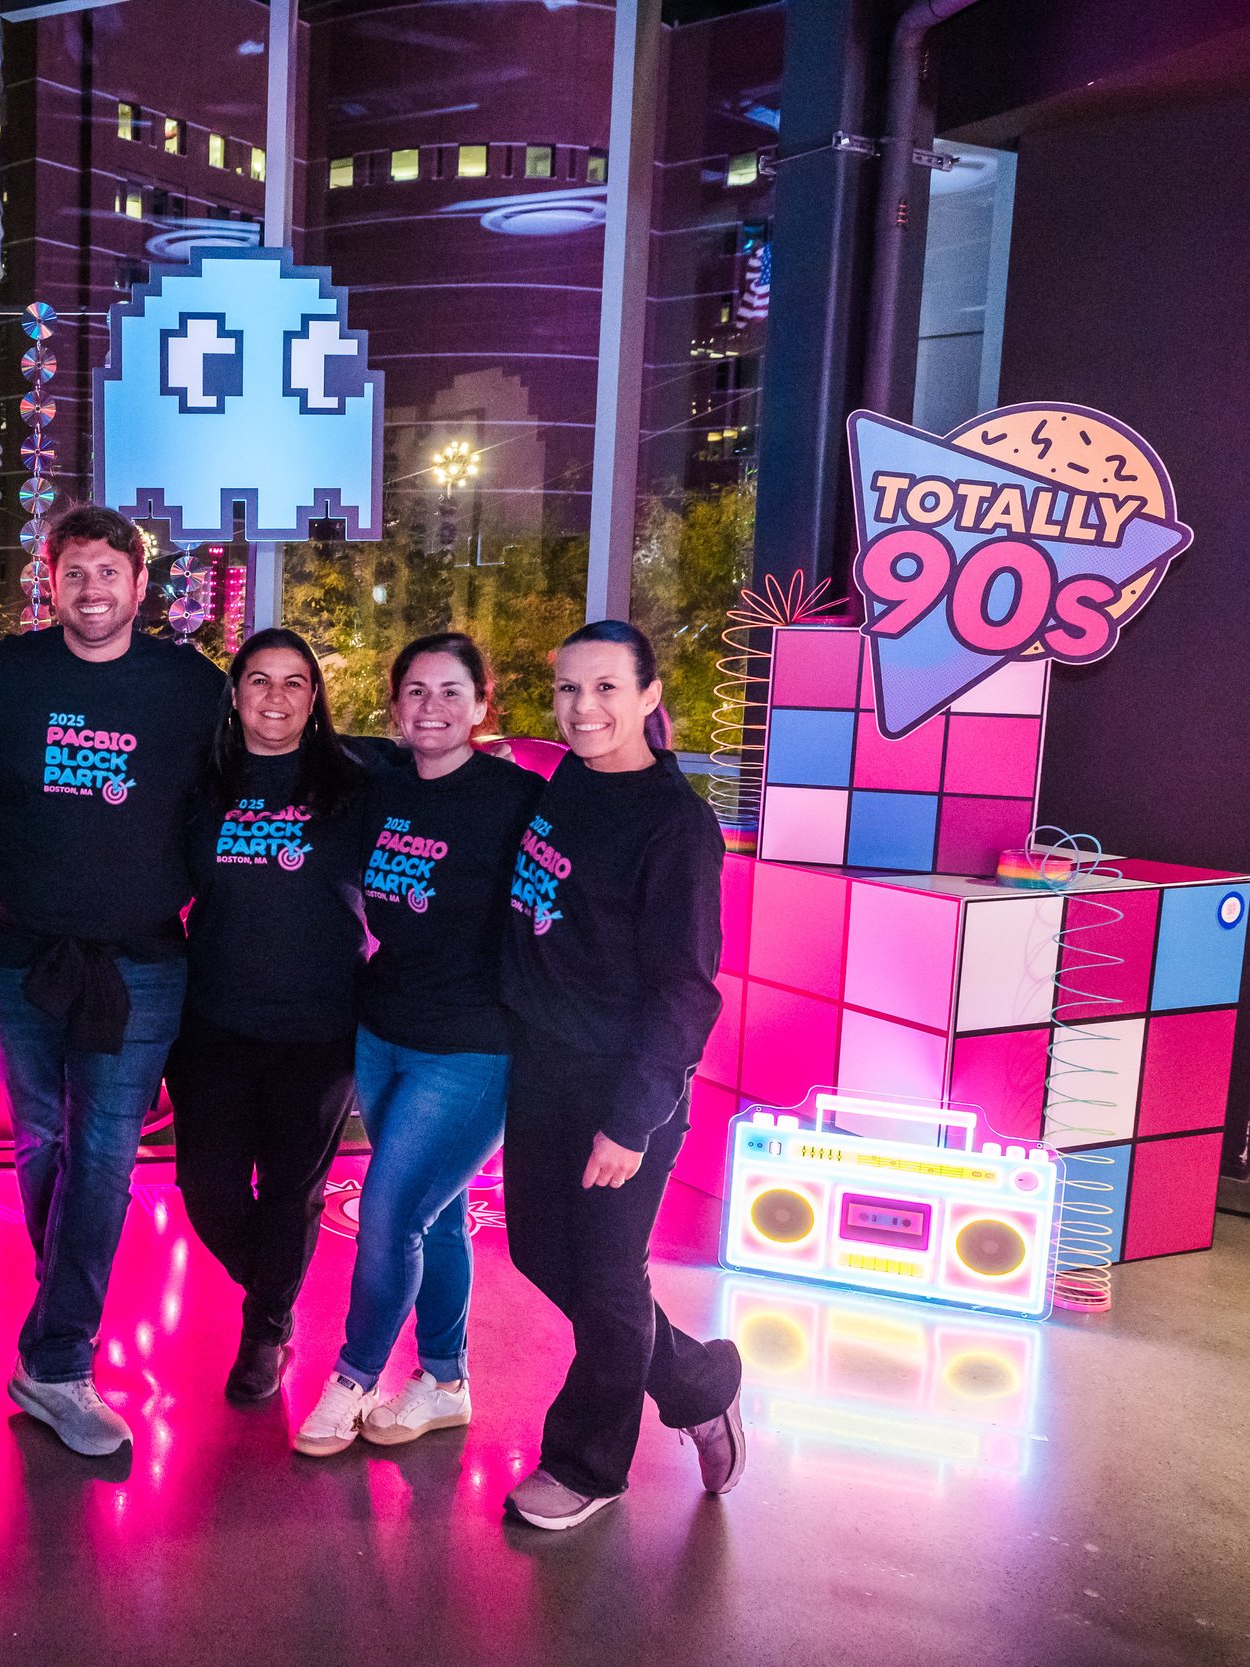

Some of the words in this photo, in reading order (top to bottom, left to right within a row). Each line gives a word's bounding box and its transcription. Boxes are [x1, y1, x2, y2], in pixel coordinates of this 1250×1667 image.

[872, 472, 1145, 546] TOTALLY
[49, 713, 85, 727] 2025
[47, 726, 137, 752] PACBIO
[45, 746, 128, 771] BLOCK
[43, 785, 79, 796] BOSTON,
[80, 788, 93, 796] MA
[44, 766, 126, 792] PARTY
[235, 798, 265, 810] 025
[220, 821, 304, 837] BLOCK
[384, 817, 411, 832] 2025
[529, 815, 553, 837] 2025
[216, 837, 302, 856] PARTY
[376, 830, 448, 860] PACBIO
[520, 829, 572, 880] PACBIO
[216, 856, 253, 865] BOSTON,
[254, 857, 268, 865] MA
[369, 849, 435, 878] BLOCK
[364, 869, 427, 901] PARTY
[365, 889, 388, 902] OSTON,
[389, 894, 400, 904] MA
[511, 875, 553, 919] ARY
